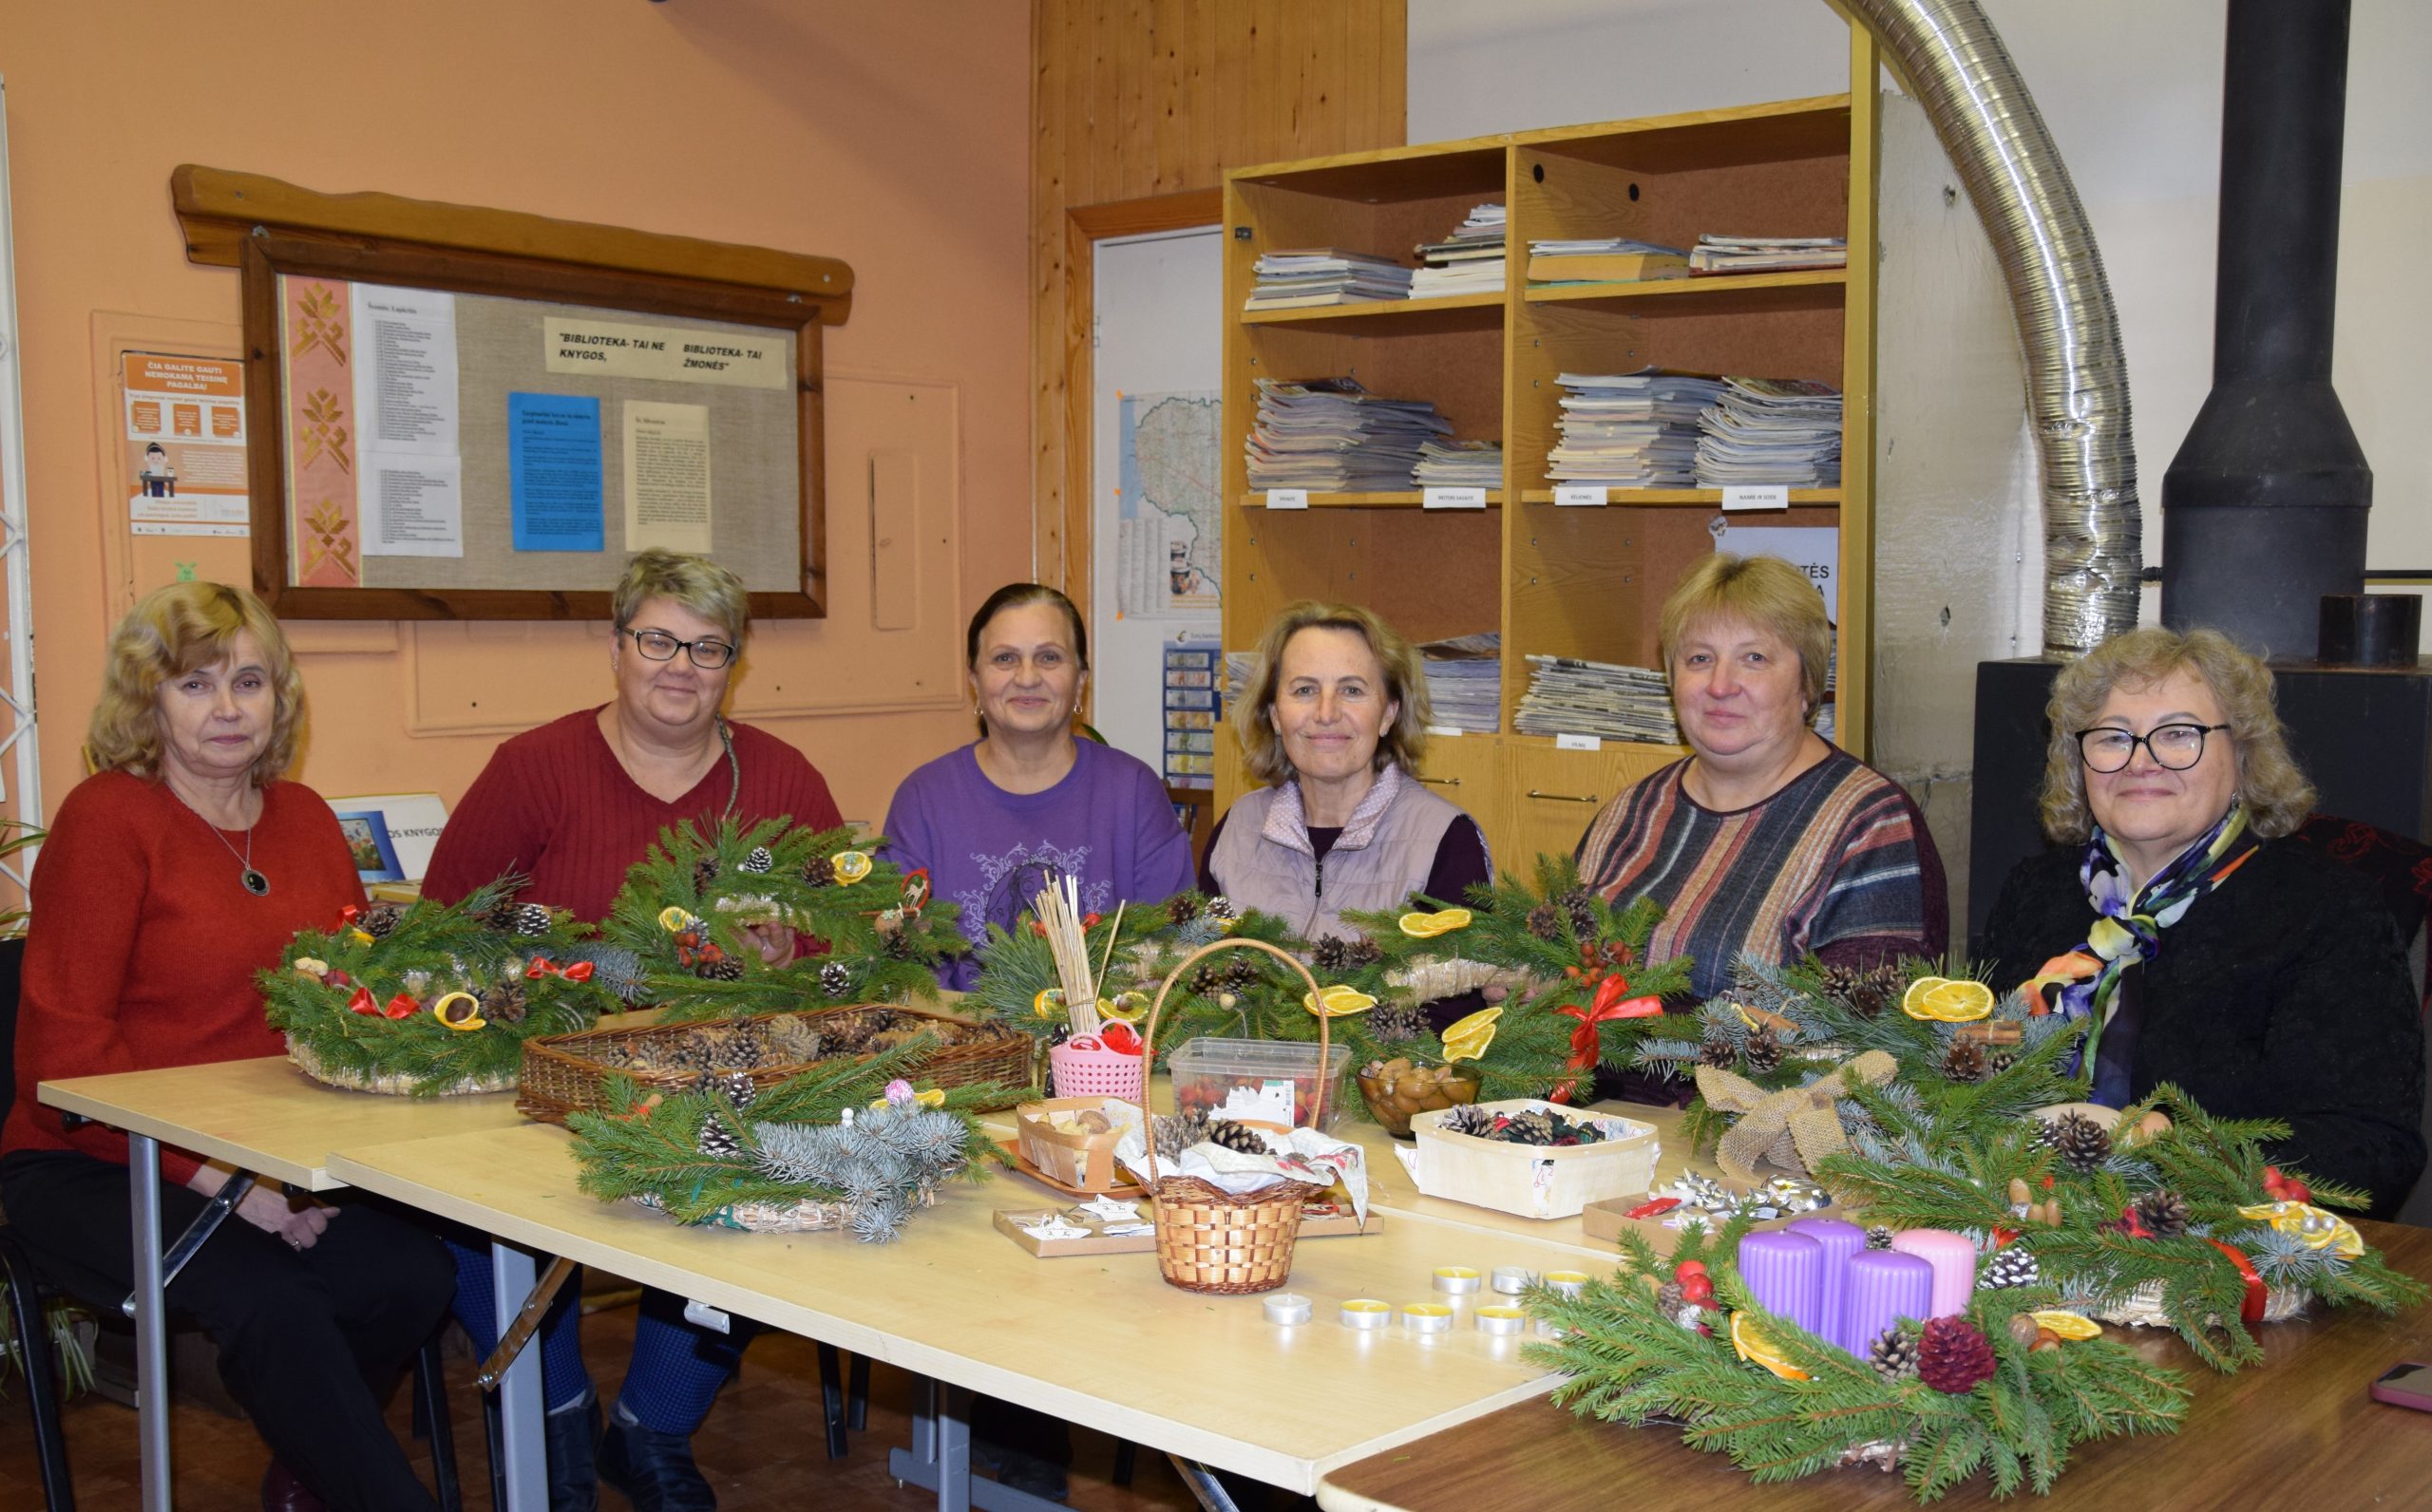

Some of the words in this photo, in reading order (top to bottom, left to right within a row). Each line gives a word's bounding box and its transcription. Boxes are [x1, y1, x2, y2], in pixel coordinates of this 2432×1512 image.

[634, 340, 649, 350] TAI
[652, 342, 665, 350] NE
[560, 349, 607, 362] KNYGOS,
[683, 344, 744, 357] BIBLIOTEKA-
[748, 350, 762, 359] TAI
[147, 361, 163, 369] ČIA
[164, 363, 195, 373] GALITE
